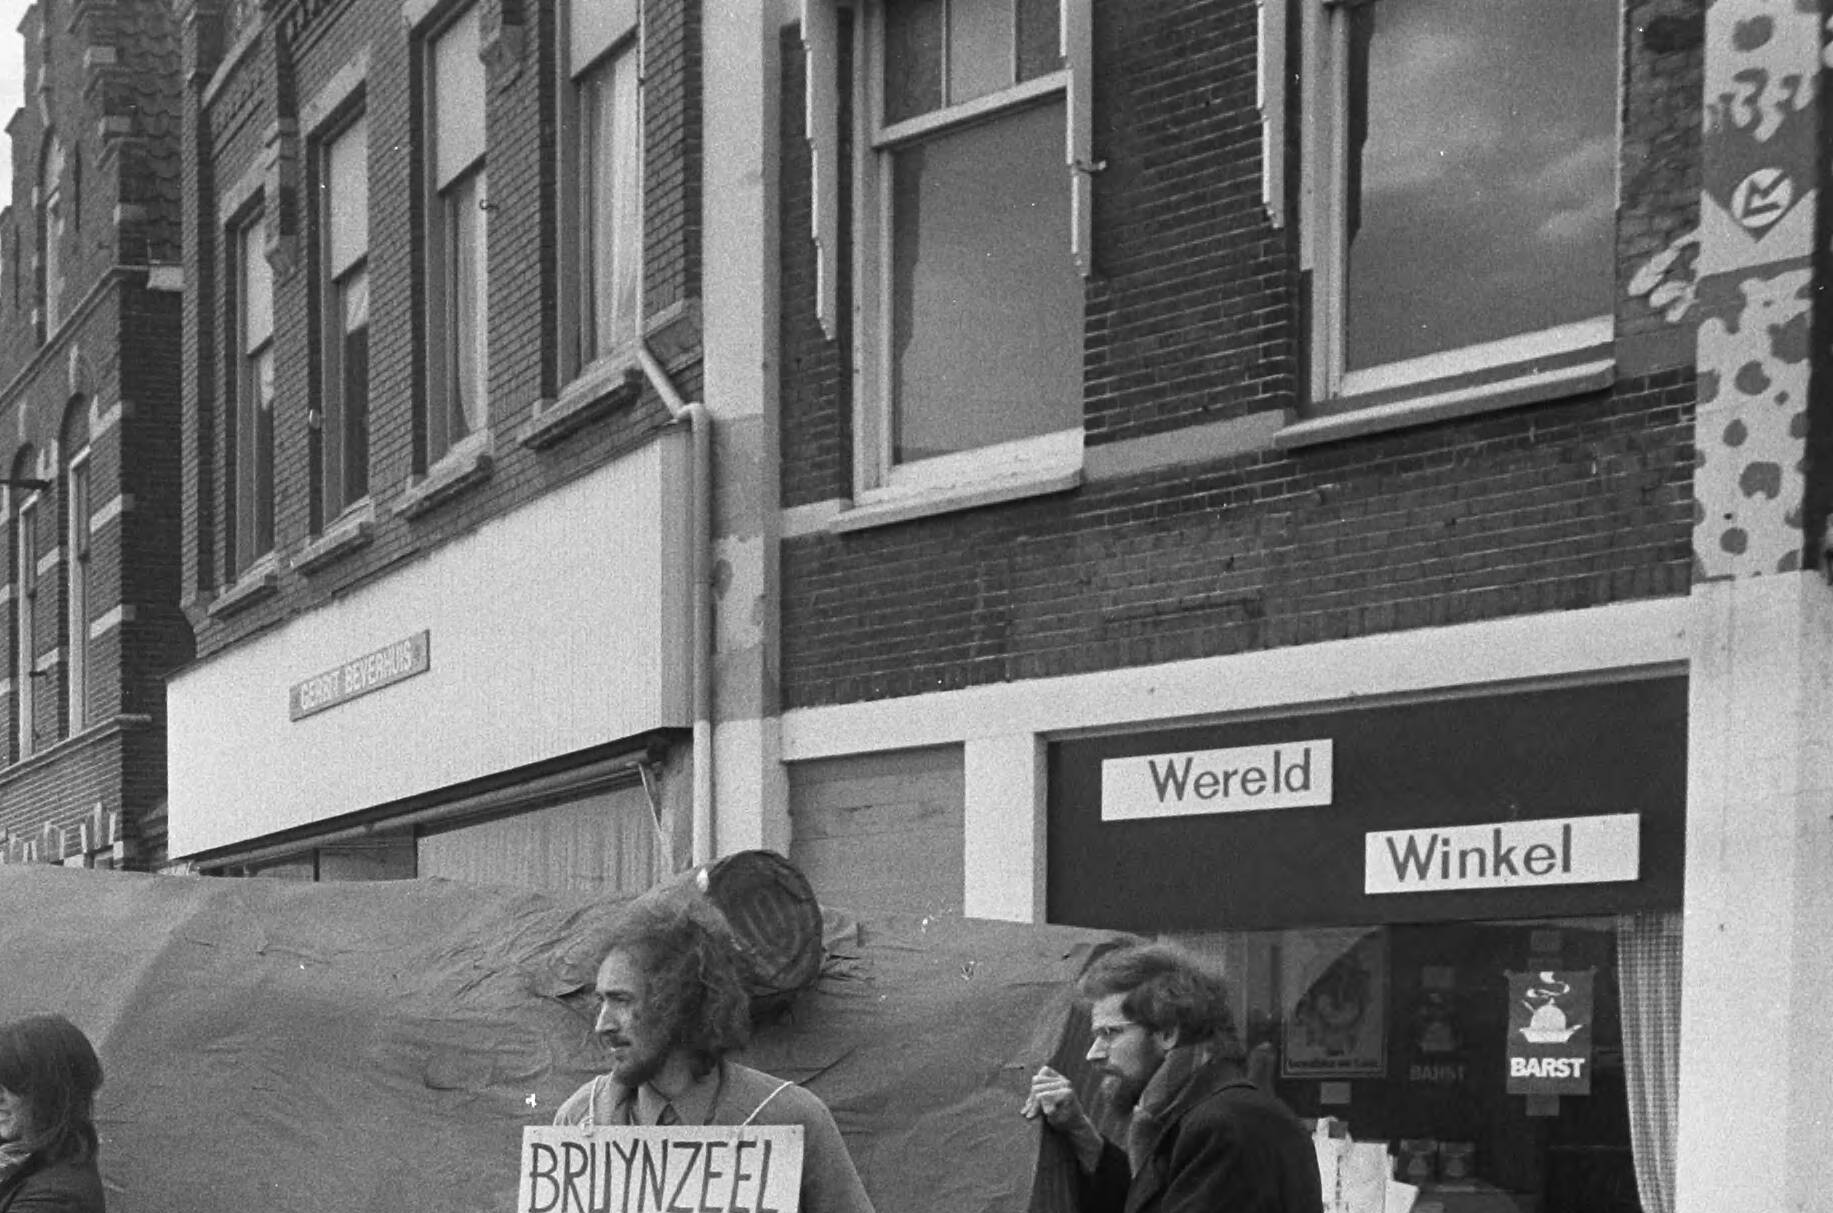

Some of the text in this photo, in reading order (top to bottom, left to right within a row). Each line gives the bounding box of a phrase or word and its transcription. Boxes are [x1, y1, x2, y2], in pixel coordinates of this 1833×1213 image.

[1148, 747, 1311, 803] Wereld
[1385, 823, 1572, 882] Winkel
[1510, 1057, 1586, 1078] BARST
